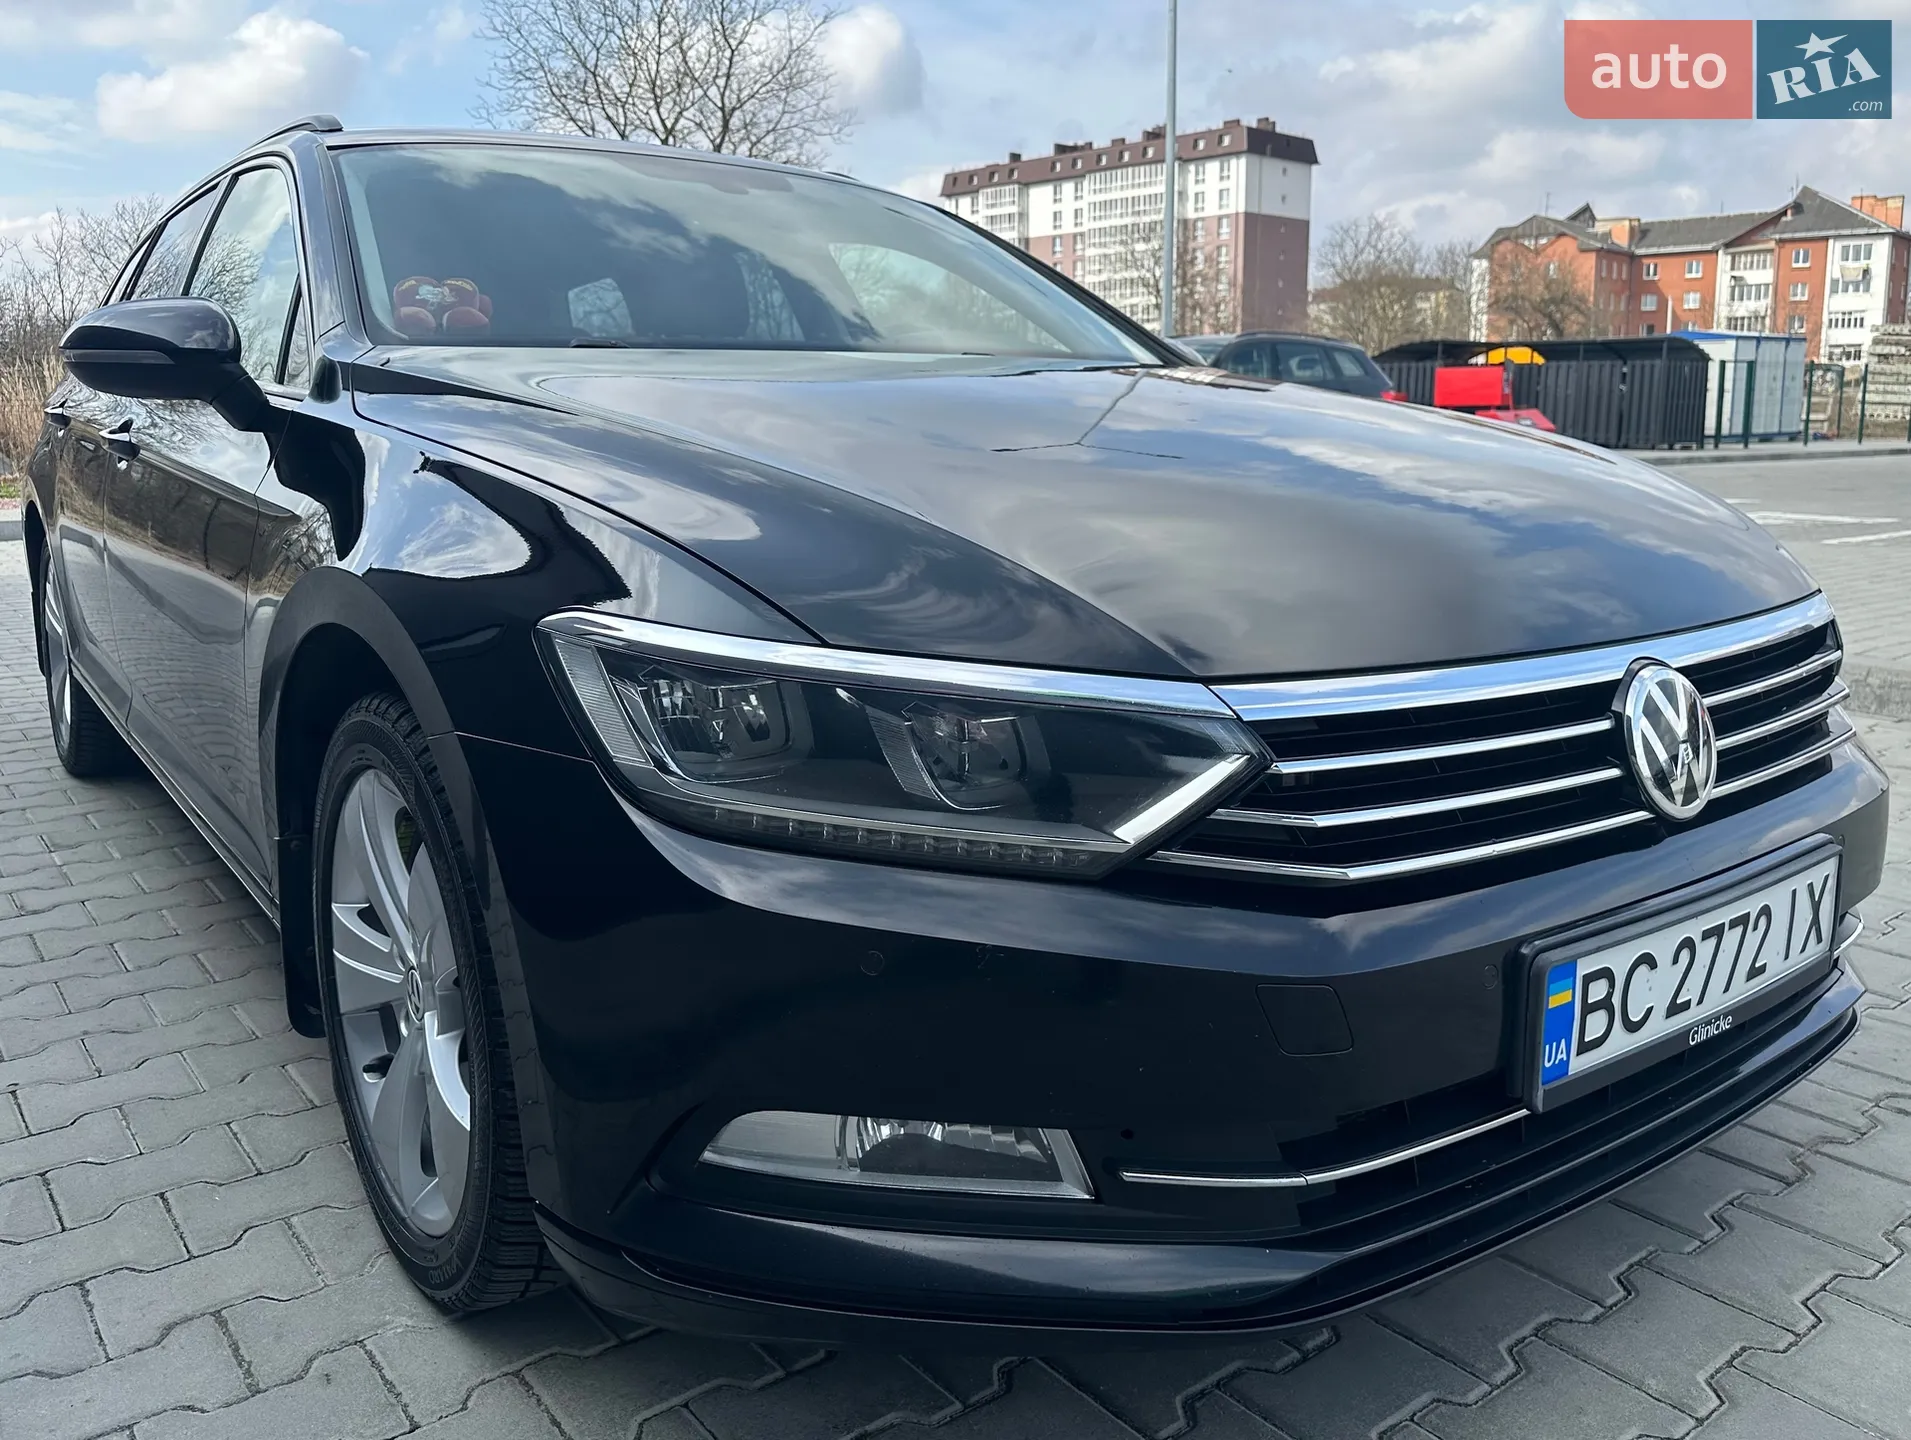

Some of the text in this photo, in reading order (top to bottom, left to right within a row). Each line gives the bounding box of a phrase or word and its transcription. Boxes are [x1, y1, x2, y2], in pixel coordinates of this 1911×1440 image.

[1576, 873, 1830, 1056] BC 2772 IX
[1689, 1013, 1733, 1046] Glinicke
[1544, 1037, 1568, 1068] UA
